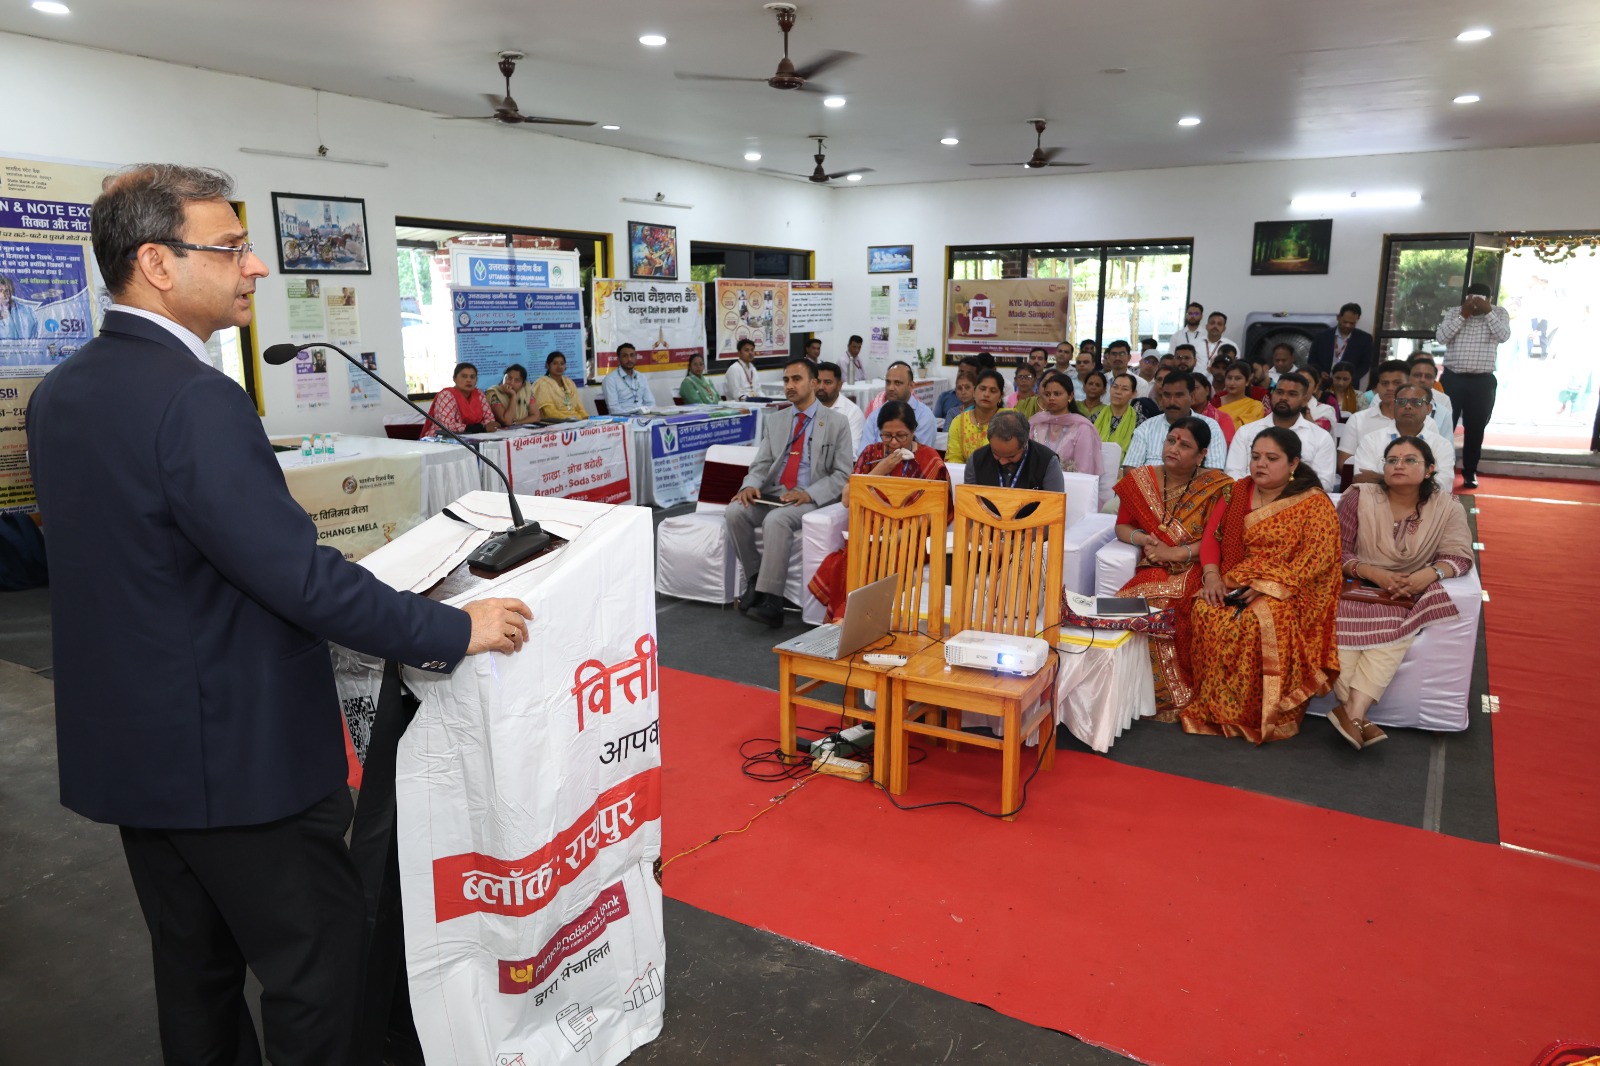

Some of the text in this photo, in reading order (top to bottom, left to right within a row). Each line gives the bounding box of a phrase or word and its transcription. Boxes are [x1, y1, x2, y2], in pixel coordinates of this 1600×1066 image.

[13, 202, 24, 213] &
[27, 203, 65, 216] NOTE
[21, 215, 87, 231] सिक्का और नोट
[613, 286, 697, 303] पंजाब नैशनल बैंक
[628, 305, 647, 316] देहरादून
[660, 306, 666, 314] का
[1008, 299, 1055, 308] KYC Updation
[1008, 310, 1055, 319] Made Simple!
[60, 318, 86, 332] SBI
[0, 388, 18, 399] SBI
[679, 432, 713, 443] UTTARAKHAND
[534, 484, 563, 496] Branch
[568, 477, 590, 488] Soda
[591, 469, 612, 482] Saroli
[542, 470, 560, 483] शाखा
[320, 508, 350, 521] विनिमय
[351, 504, 369, 514] मेला
[358, 522, 378, 533] MELA
[565, 792, 635, 870] रायपुर
[584, 932, 592, 940] you
[535, 941, 562, 977] punjab
[562, 910, 600, 945] national
[534, 940, 611, 1006] द्वारा संचालित
